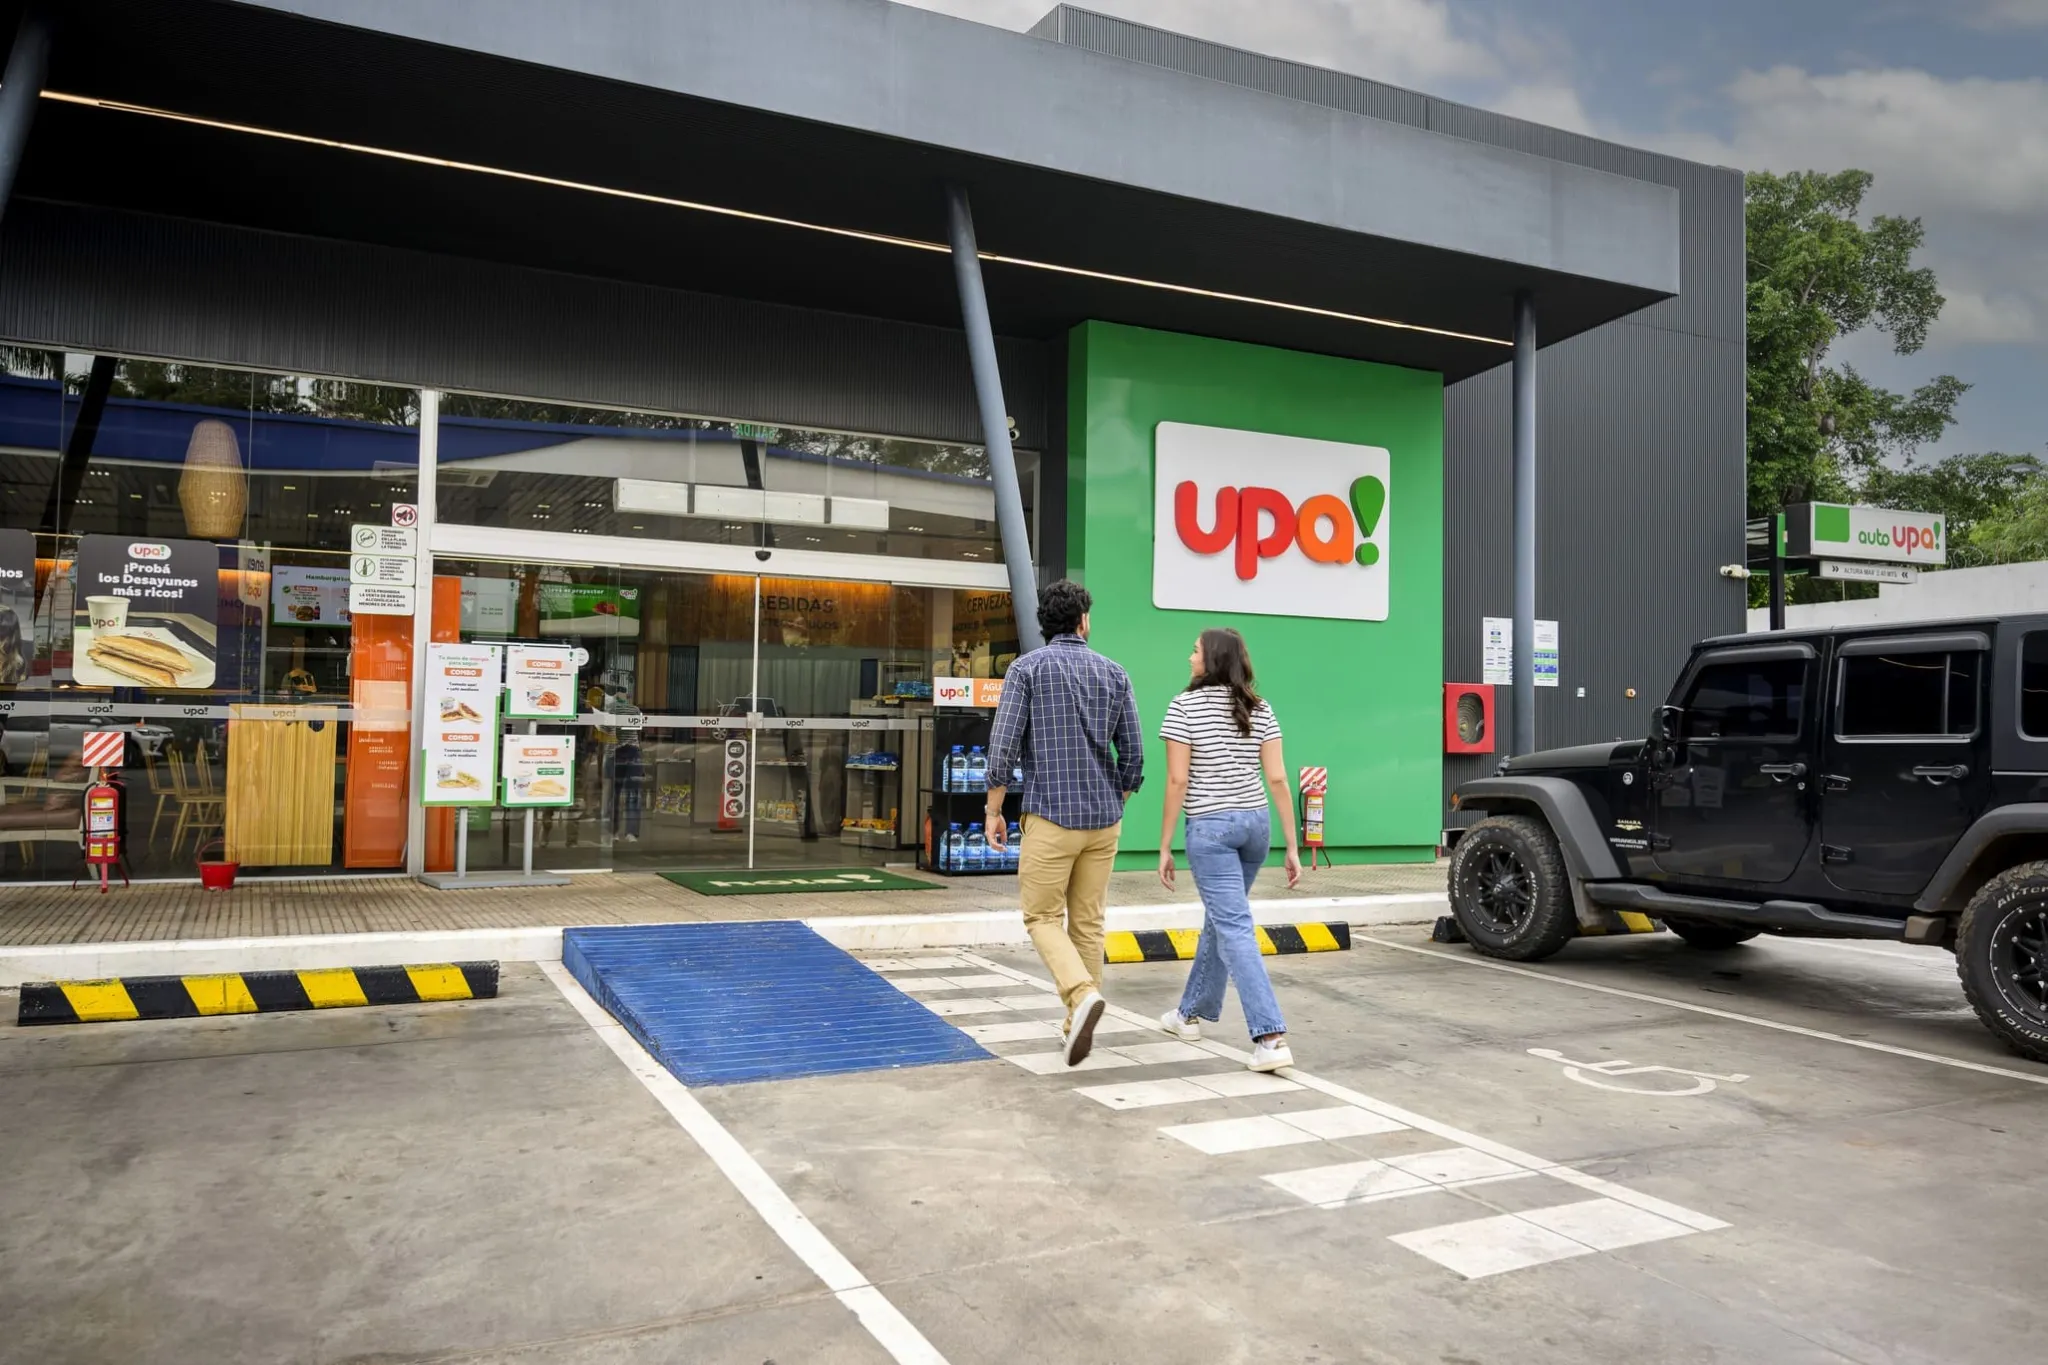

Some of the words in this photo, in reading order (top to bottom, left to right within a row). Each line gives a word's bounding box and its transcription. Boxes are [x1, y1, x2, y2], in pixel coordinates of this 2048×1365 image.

[1174, 475, 1386, 581] upa!
[1858, 528, 1890, 547] auto
[1893, 521, 1941, 556] upa!
[134, 546, 165, 557] upa!
[0, 567, 23, 578] hos
[124, 562, 171, 574] ¡Probá
[99, 573, 120, 583] los
[123, 574, 198, 587] Desayunos
[113, 586, 141, 596] más
[145, 587, 183, 598] ricos!
[940, 685, 970, 700] upa!
[983, 683, 1002, 691] AGU
[87, 704, 114, 714] upa!
[183, 707, 209, 716] upa!
[700, 718, 720, 726] upa!
[786, 719, 805, 727] upa!
[852, 720, 870, 728] upa!
[1609, 837, 1648, 846] WRANGLER
